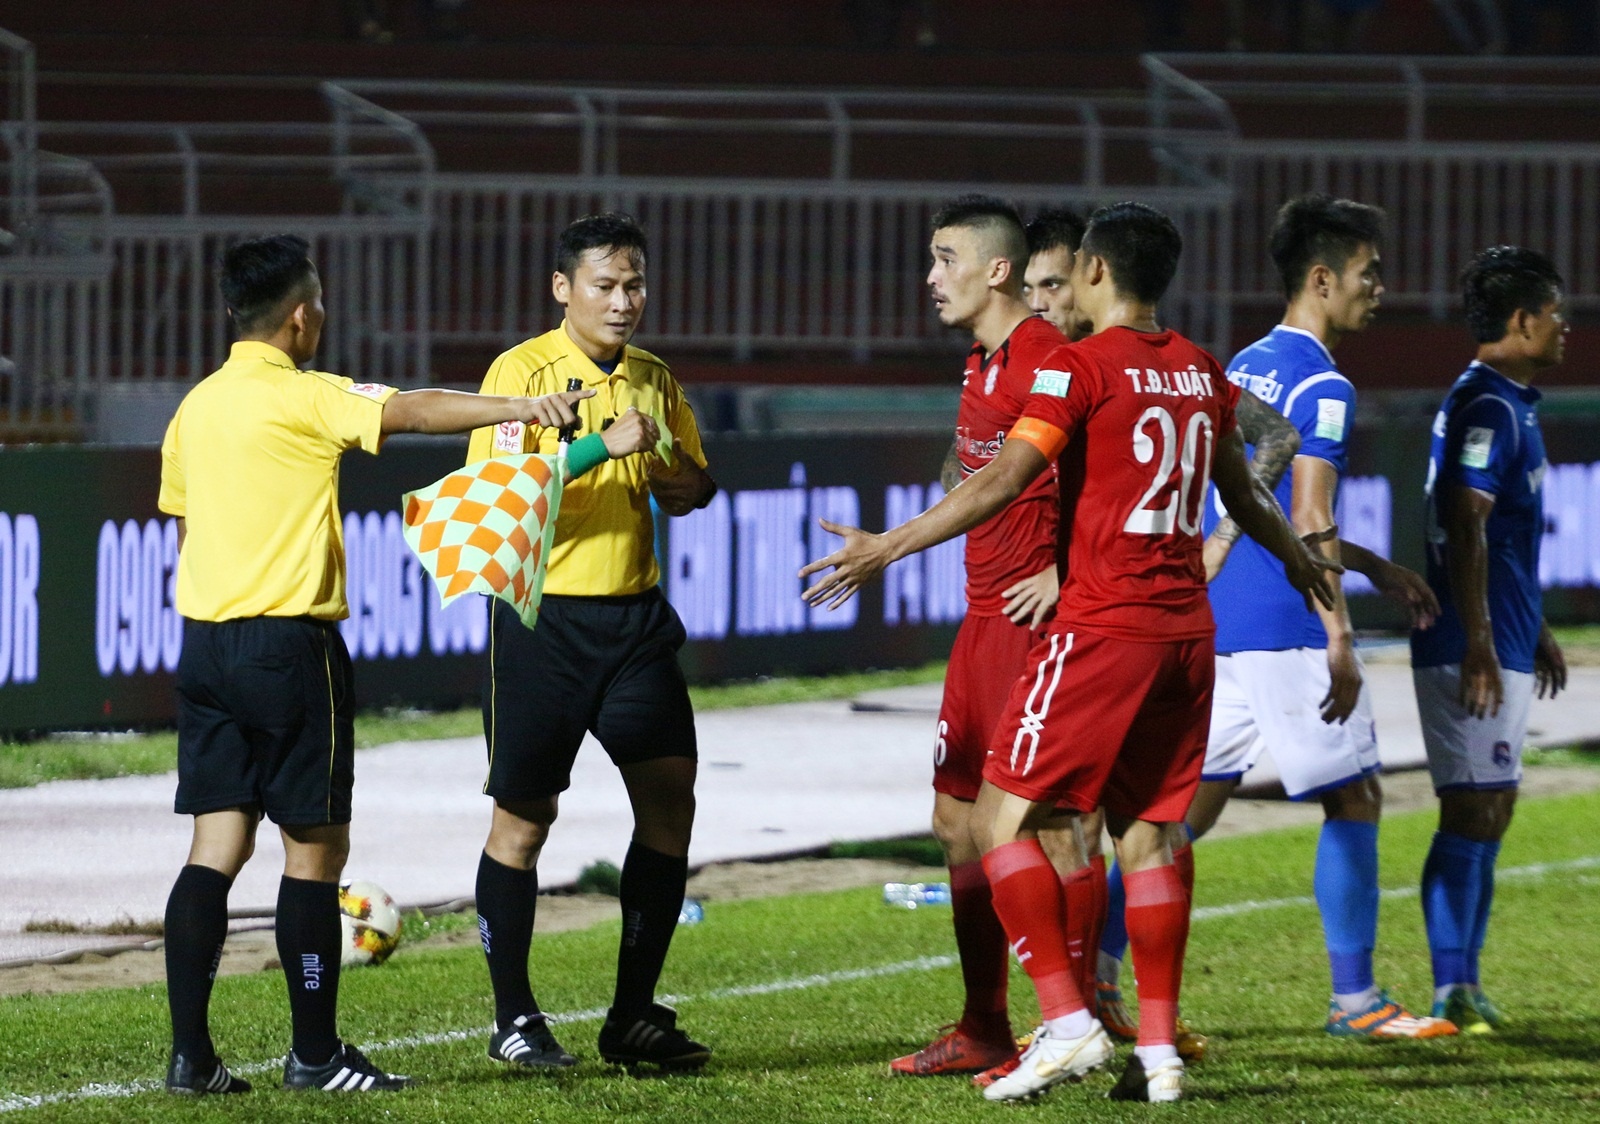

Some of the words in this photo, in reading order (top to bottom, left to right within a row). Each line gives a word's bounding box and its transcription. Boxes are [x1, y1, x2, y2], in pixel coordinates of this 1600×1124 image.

[497, 438, 519, 449] VPF
[1123, 406, 1213, 537] 20
[301, 953, 324, 990] mitre
